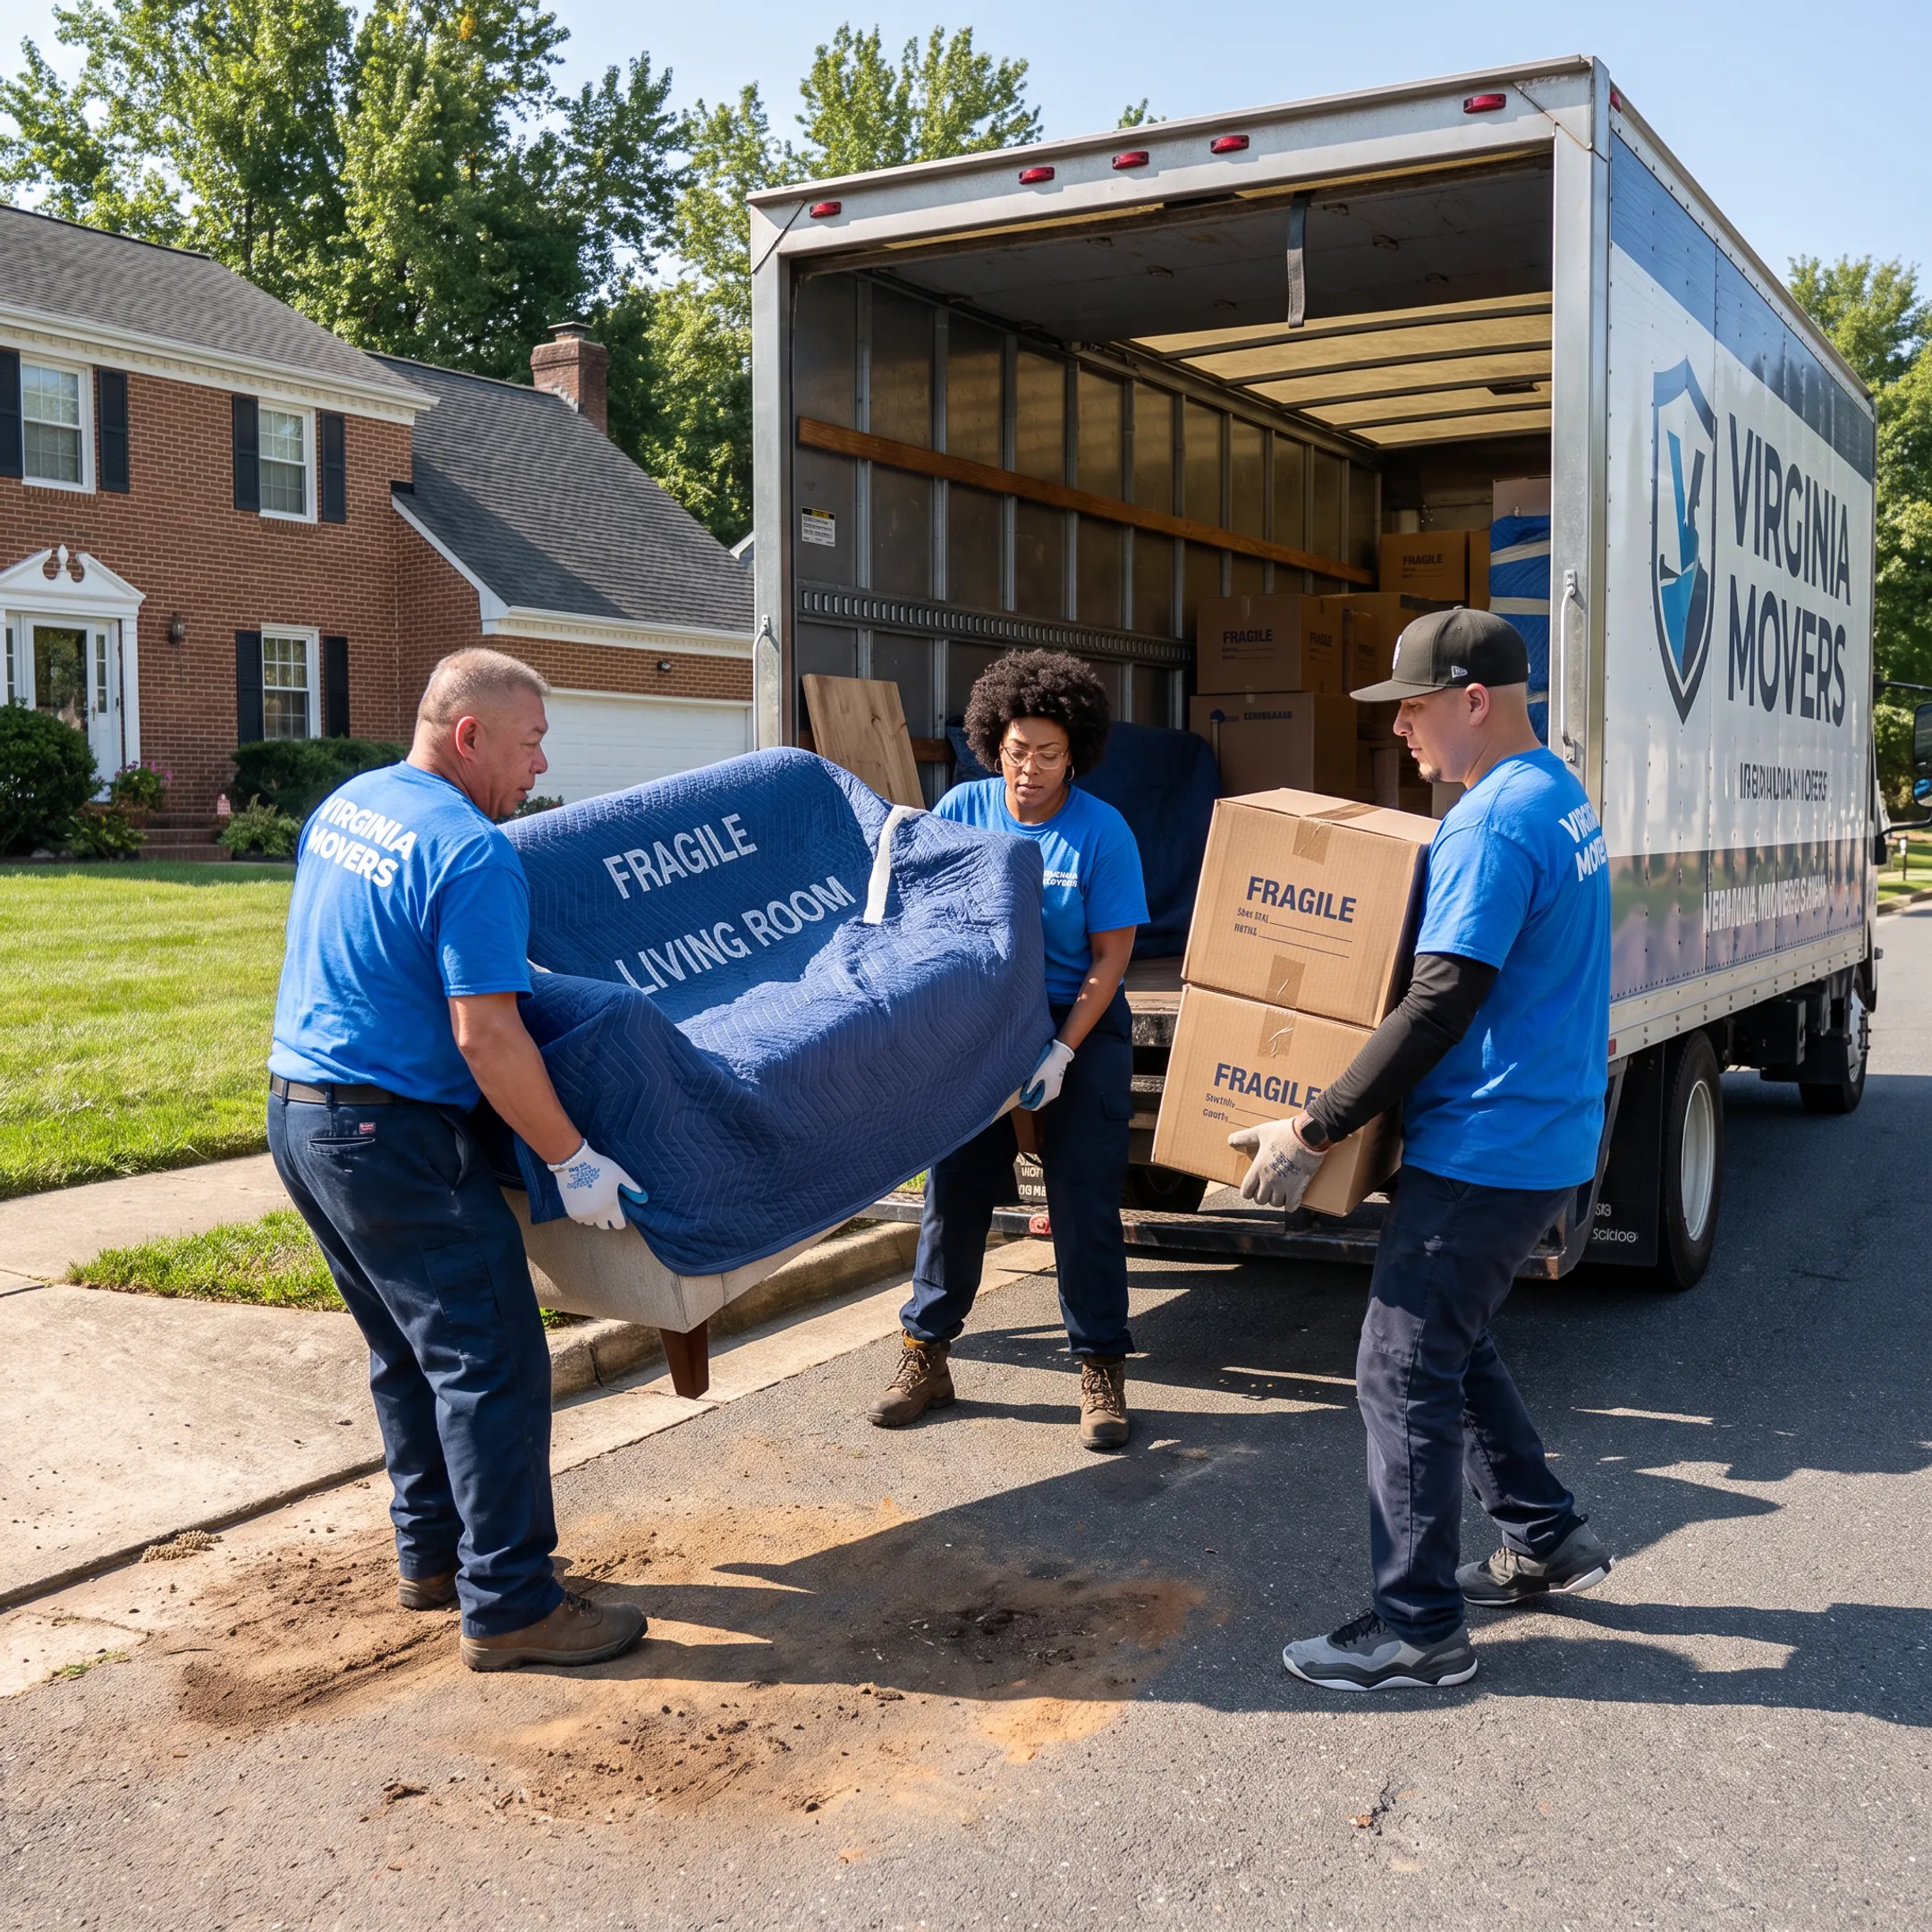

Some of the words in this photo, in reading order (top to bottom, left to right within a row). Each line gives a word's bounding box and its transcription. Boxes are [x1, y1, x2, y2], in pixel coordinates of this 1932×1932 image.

[1729, 411, 1851, 606] VIRGINIA
[1402, 554, 1443, 565] FRAGILE
[1223, 629, 1273, 643] FRAGILE
[1727, 574, 1847, 728] MOVERS
[307, 825, 400, 888] MOVERS
[319, 796, 418, 861] VIRGINIA
[603, 813, 758, 900] FRAGILE
[1246, 876, 1357, 923] FRAGILE
[614, 922, 752, 996] LIVING
[741, 876, 856, 947] ROOM
